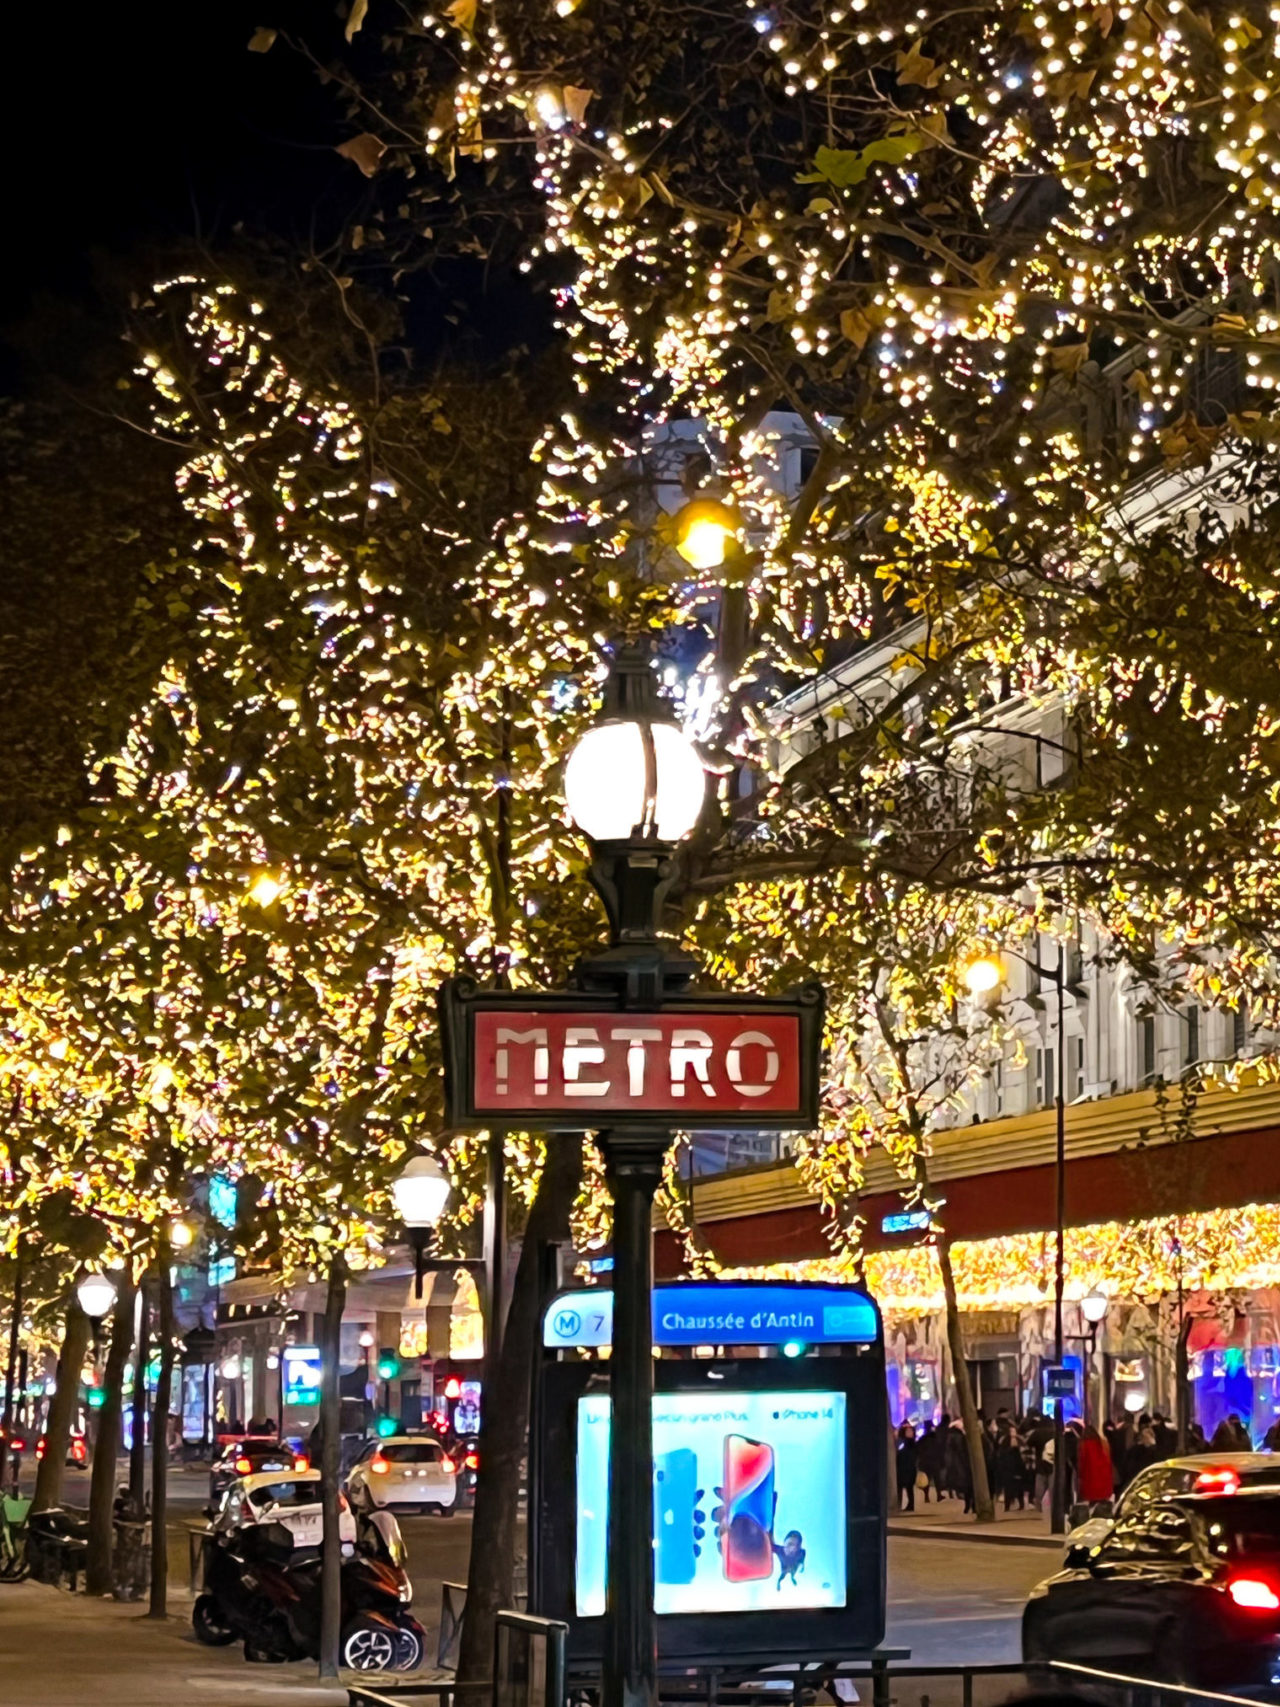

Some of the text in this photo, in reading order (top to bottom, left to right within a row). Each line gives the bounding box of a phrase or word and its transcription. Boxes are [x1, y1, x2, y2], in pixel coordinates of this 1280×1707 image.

[496, 1027, 780, 1097] METRO
[593, 1314, 605, 1332] 7
[661, 1311, 814, 1331] Chaussée d'Antin
